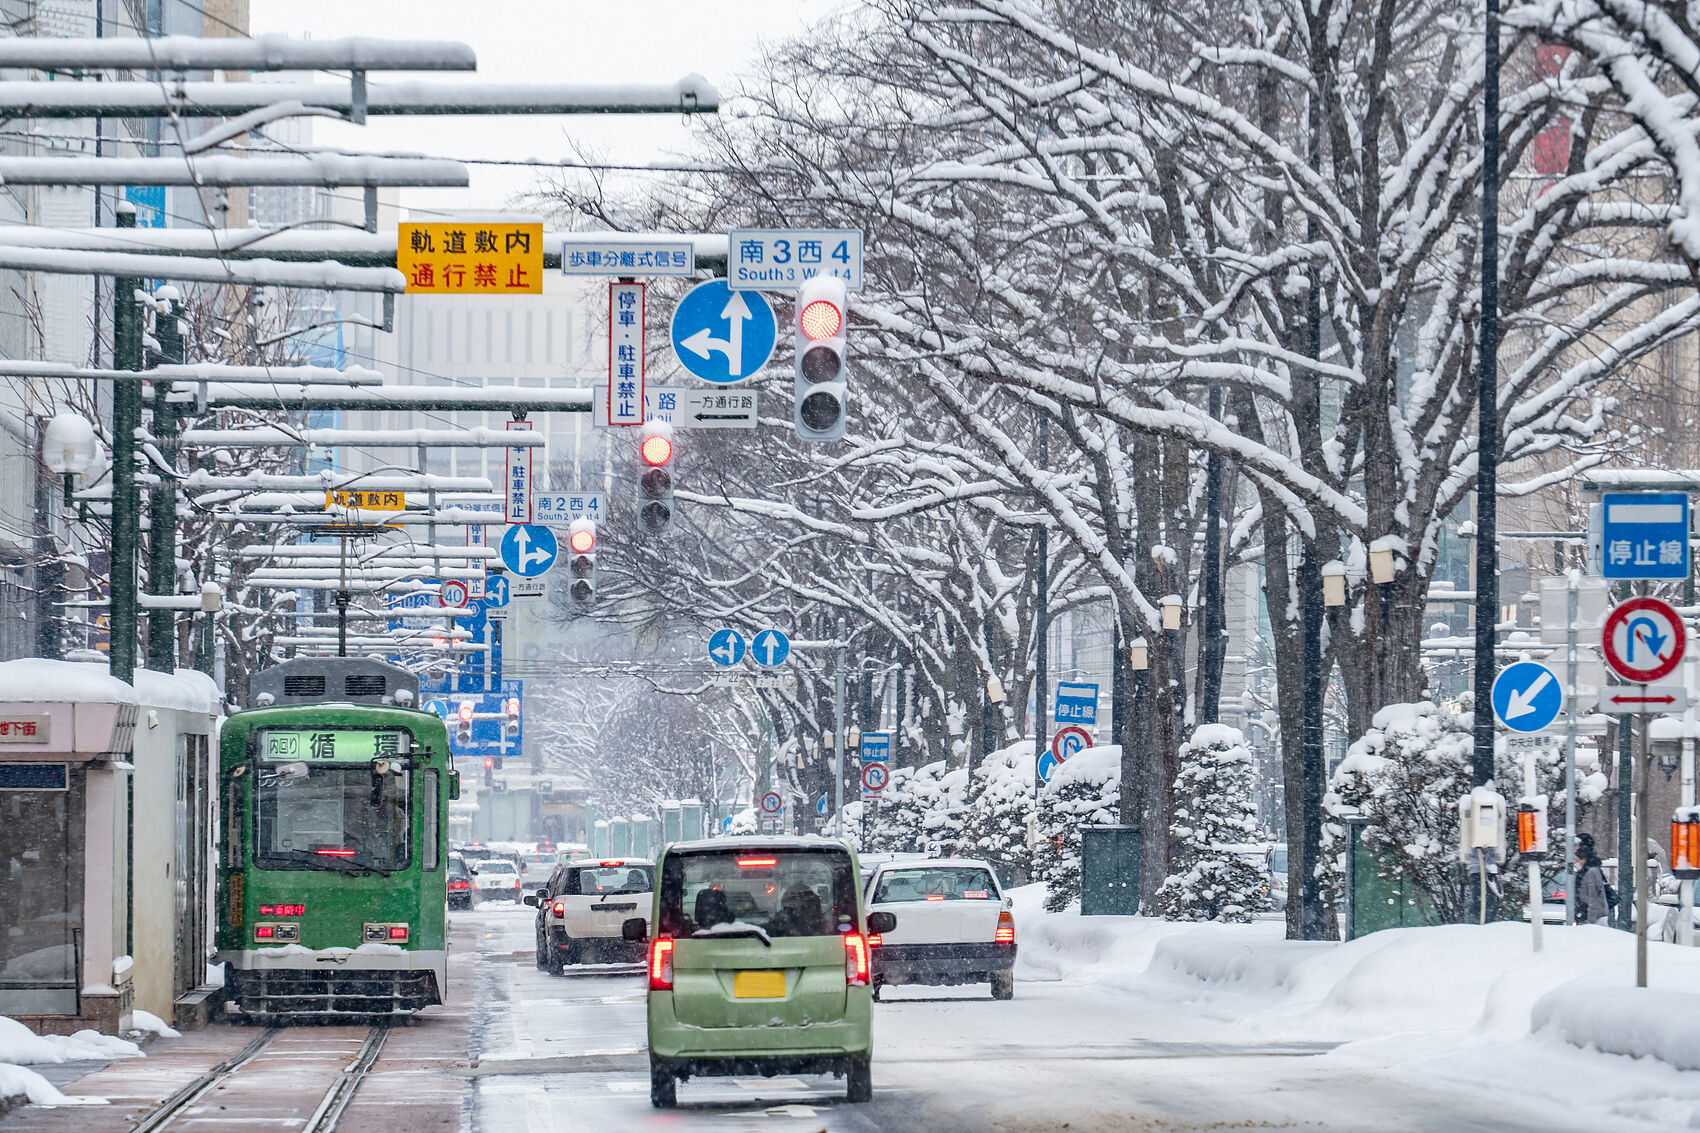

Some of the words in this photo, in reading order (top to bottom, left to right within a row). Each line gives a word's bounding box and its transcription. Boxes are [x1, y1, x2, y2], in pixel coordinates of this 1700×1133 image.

[410, 229, 530, 254] 軌道敷内
[569, 250, 688, 268] 歩車分離式信号
[740, 239, 850, 264] 南3西4
[410, 263, 530, 288] 通行禁止
[802, 268, 839, 280] Wt
[617, 291, 636, 417] 停車・駐車禁止
[690, 396, 753, 409] 一方通行路
[512, 427, 525, 518] ・駐車禁止
[538, 497, 598, 511] 南2西4
[572, 513, 592, 521] Wst
[1608, 539, 1683, 566] 停止線
[445, 589, 462, 603] 40
[1058, 704, 1094, 718] 停止線
[270, 738, 298, 754] 内回り
